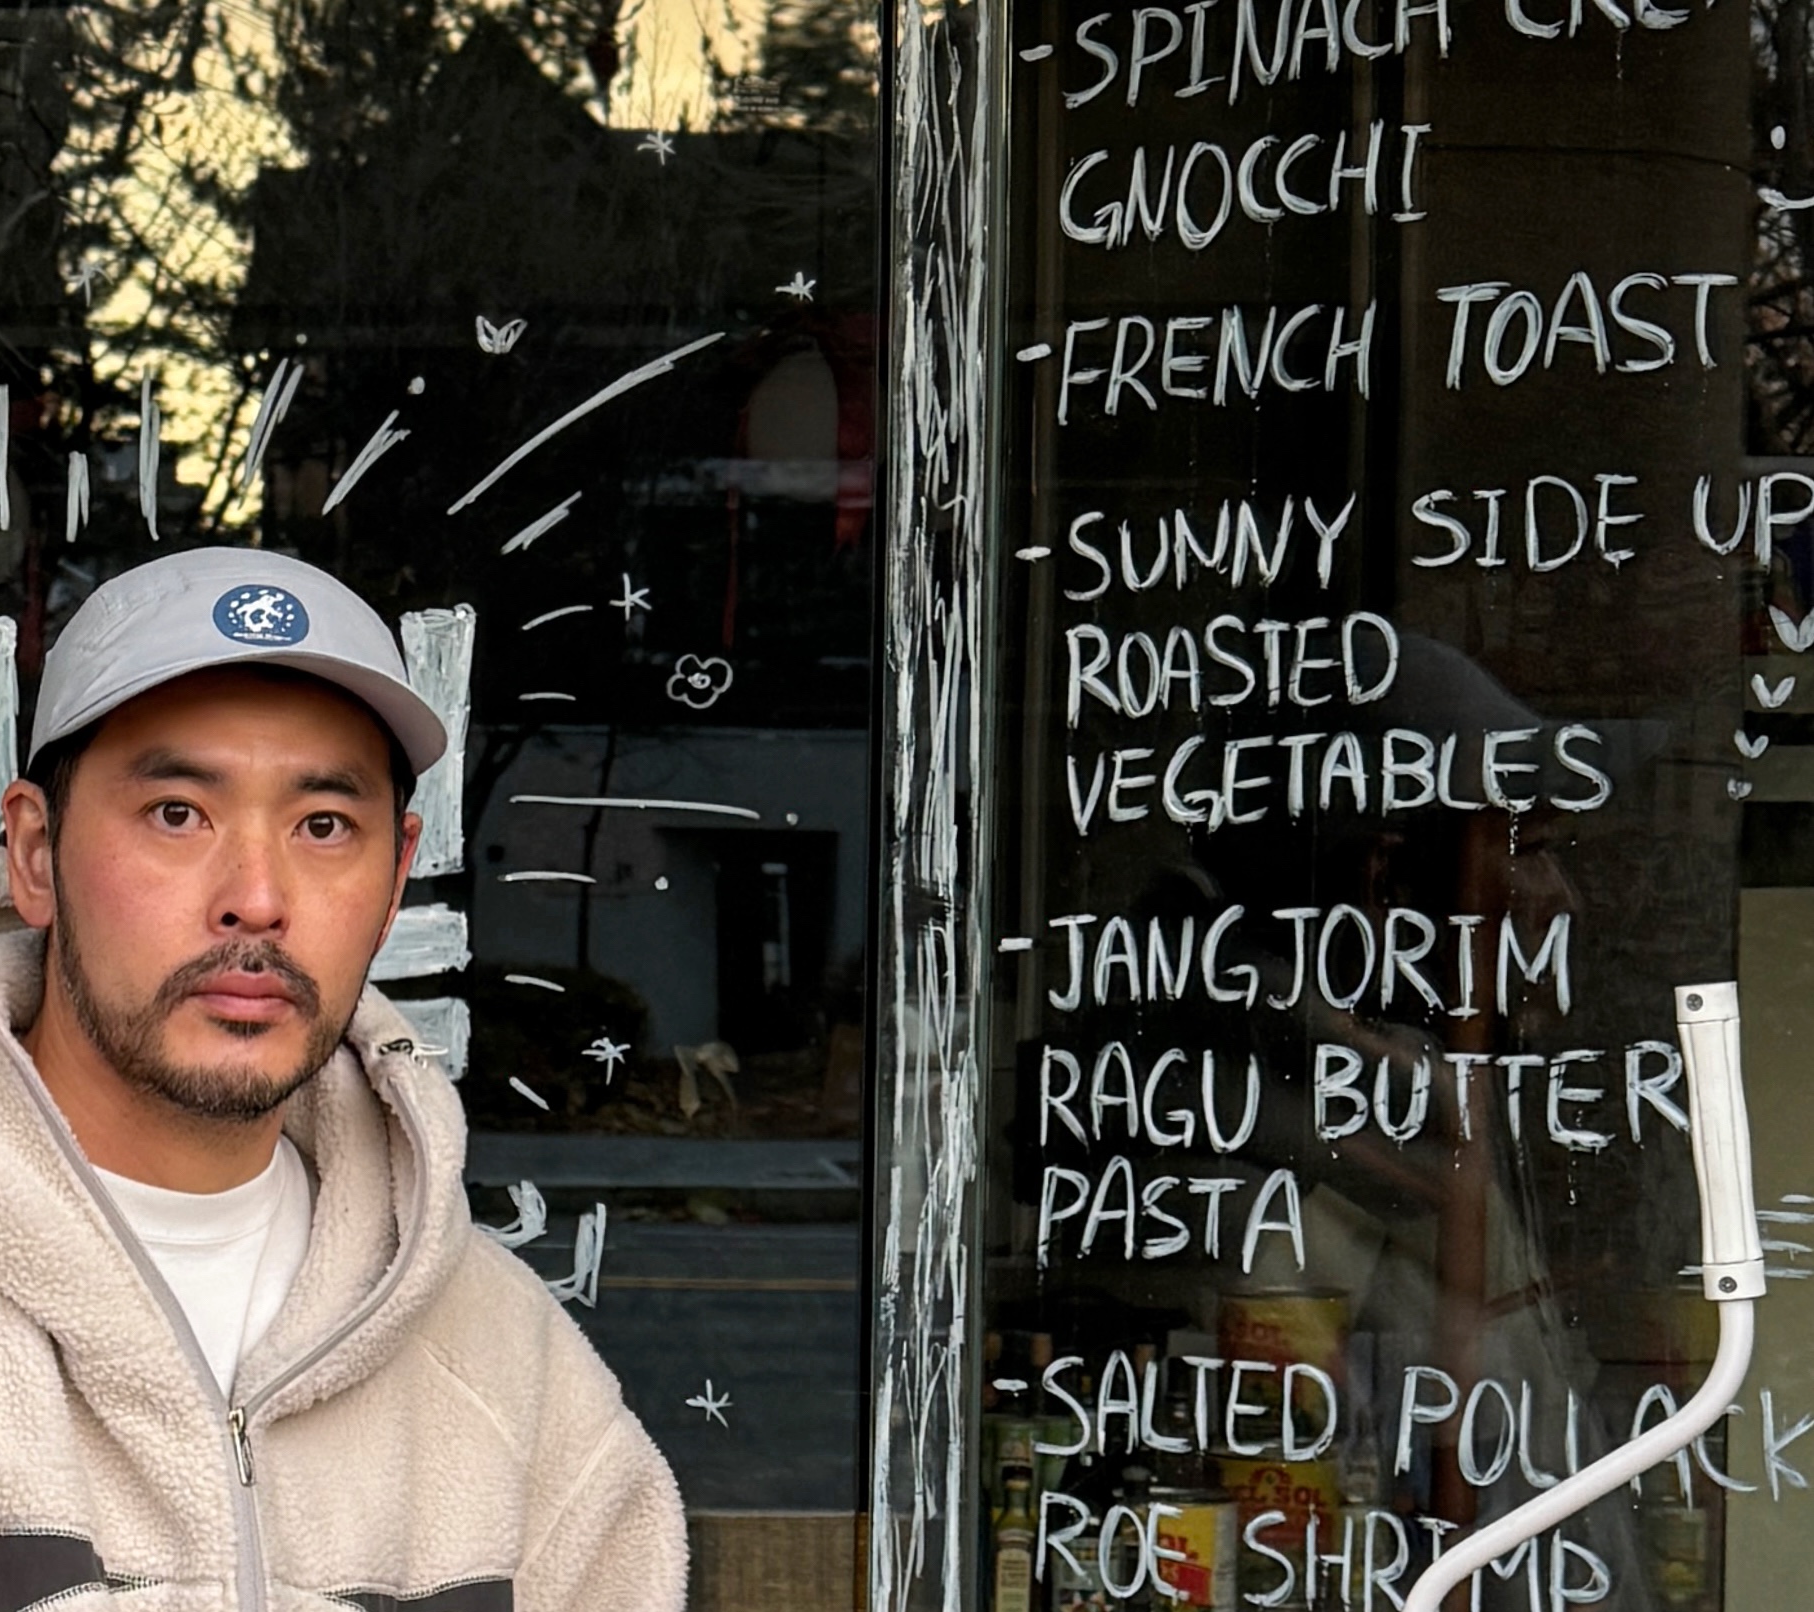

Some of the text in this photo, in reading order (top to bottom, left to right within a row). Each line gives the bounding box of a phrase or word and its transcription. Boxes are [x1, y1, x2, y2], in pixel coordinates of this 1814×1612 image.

[1059, 119, 1433, 250] GNOCCHI
[1436, 271, 1739, 390] TOAST
[1411, 473, 1645, 573] SIDE
[1693, 472, 1814, 571] UP
[1066, 611, 1399, 729] ROASTED
[1066, 722, 1611, 835] VEGETABLES
[1040, 1040, 1690, 1153] RAGU BUTTER
[1038, 1155, 1305, 1275] PASTA
[1037, 1491, 1189, 1600] ROE
